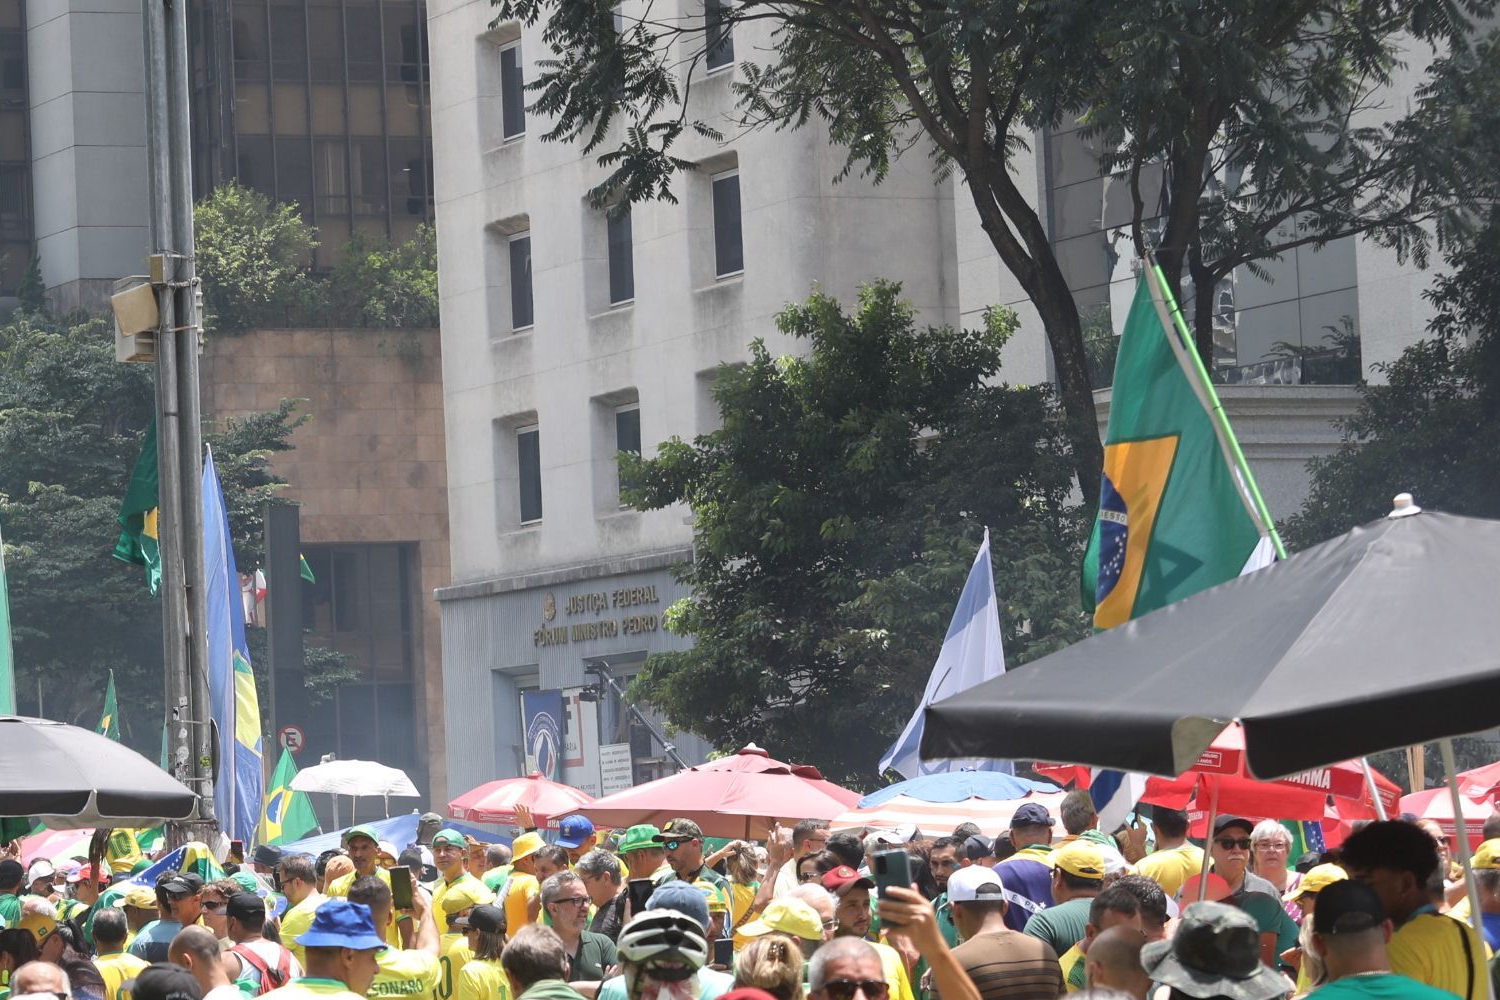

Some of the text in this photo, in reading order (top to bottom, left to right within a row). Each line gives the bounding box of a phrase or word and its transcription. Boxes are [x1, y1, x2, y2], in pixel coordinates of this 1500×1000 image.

[565, 585, 659, 615] JUSTIÇA FEDERAL
[533, 615, 658, 647] FÓRUM MINISTRO PEDRO
[366, 978, 424, 997] SONARO
